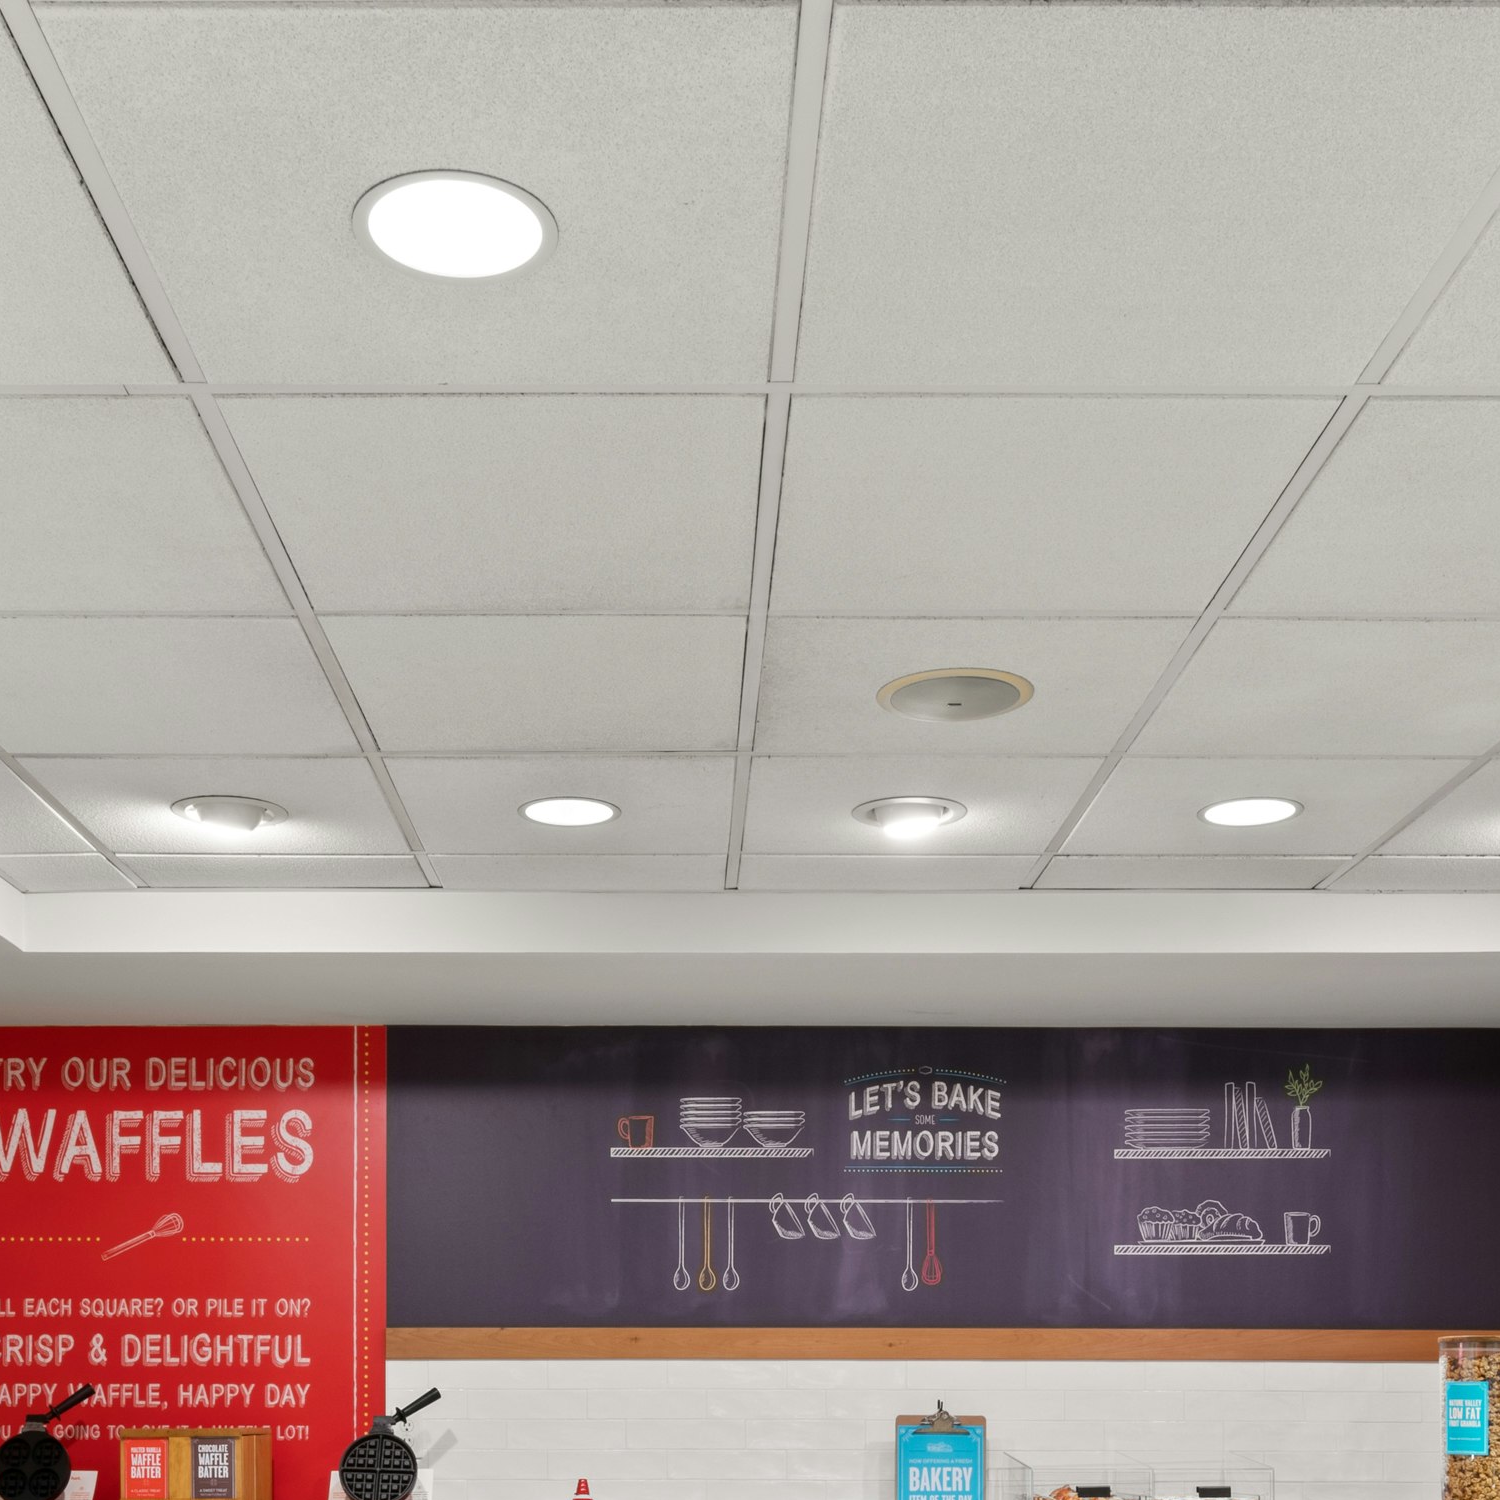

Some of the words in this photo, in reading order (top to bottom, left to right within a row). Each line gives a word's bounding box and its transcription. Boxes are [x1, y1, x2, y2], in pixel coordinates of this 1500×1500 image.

[61, 1057, 131, 1092] OUR
[145, 1057, 315, 1091] DELICIOUS
[849, 1080, 921, 1120] LET'S
[932, 1081, 1001, 1120] BAKE
[915, 1114, 936, 1125] SOME
[850, 1130, 999, 1161] MEMORIES
[23, 1298, 72, 1317] EACH
[79, 1298, 164, 1318] SQUARE?
[172, 1298, 198, 1317] OR
[205, 1298, 244, 1317] PILE
[251, 1298, 268, 1317] IT
[275, 1298, 311, 1317] ON?
[88, 1333, 108, 1367] &
[121, 1333, 311, 1367] DELIGHTFUL
[177, 1383, 255, 1408] HAPPY
[264, 1383, 311, 1408] DAY
[1449, 1407, 1463, 1419] LOW
[1465, 1407, 1481, 1419] FAT
[53, 1424, 101, 1440] GOING
[276, 1425, 309, 1441] LOT!
[198, 1444, 228, 1453] CHOCOLATE
[131, 1453, 161, 1466] WAFFLE
[198, 1453, 229, 1465] WAFFLE
[131, 1466, 161, 1478] BATTER
[198, 1466, 229, 1478] BATTER
[909, 1467, 973, 1491] BAKERY
